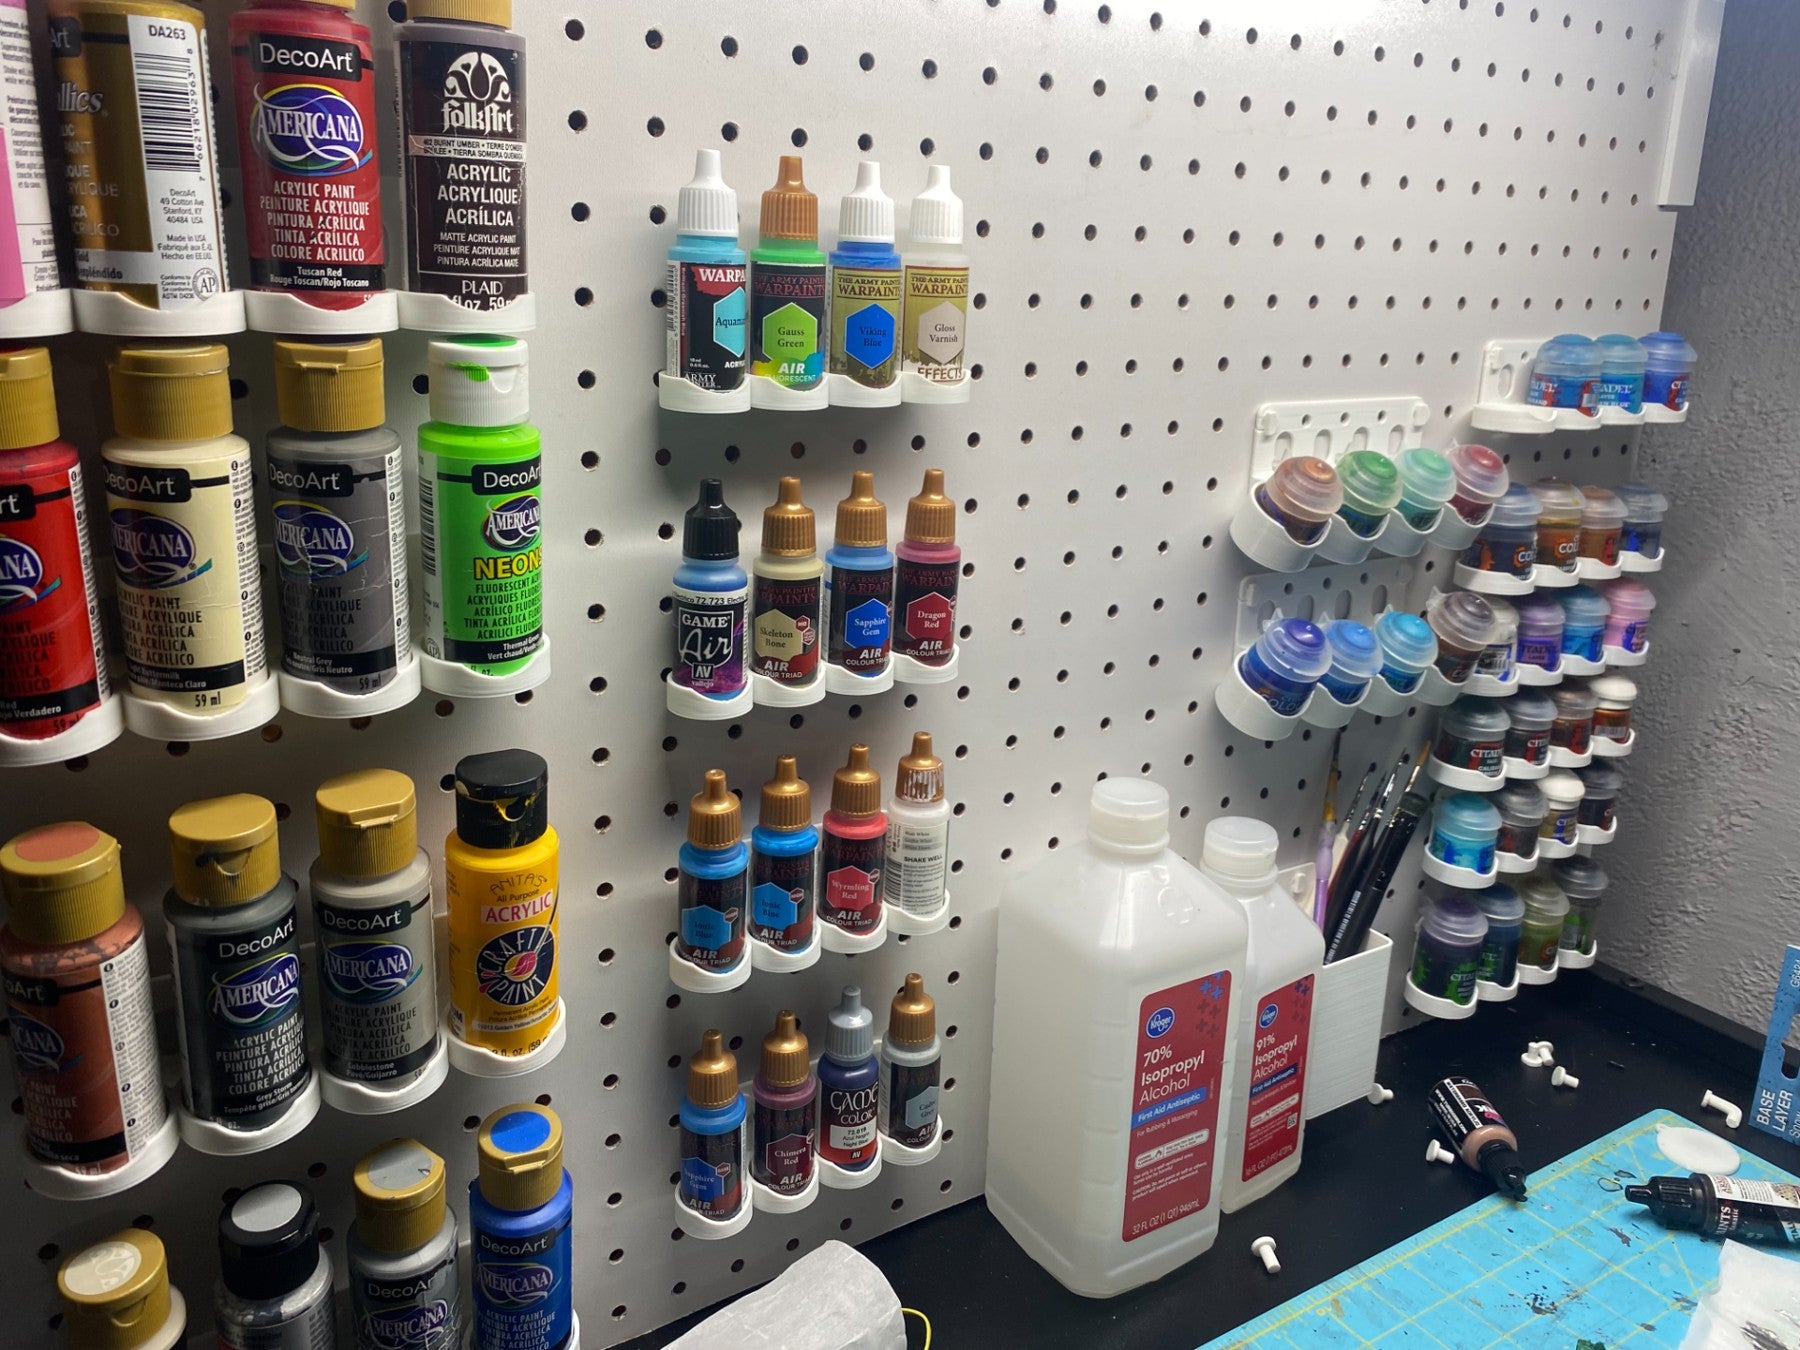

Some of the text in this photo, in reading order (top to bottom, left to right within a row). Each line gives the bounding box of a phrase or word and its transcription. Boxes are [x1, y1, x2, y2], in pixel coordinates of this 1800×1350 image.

[148, 24, 186, 40] DA263
[260, 43, 353, 73] DecoArt
[255, 102, 361, 143] AMERICANA
[434, 138, 505, 151] BURNT UMBER TERRE
[452, 148, 503, 159] TIERRA SOMBRA
[446, 163, 511, 183] ACRYLIC
[273, 180, 356, 199] ACRYLIC PAINT
[437, 185, 518, 205] ACRYLIQUE
[260, 196, 370, 216] PEINTURE ACRYLIQUE
[266, 212, 366, 231] PINTURA ACRÍLICA
[445, 205, 514, 226] ACRÍLICA
[166, 234, 187, 242] Made
[274, 228, 360, 246] TINTA ACRÍLICA
[440, 231, 517, 244] MATTE ACRYLIC PAINT
[161, 252, 184, 260] Hecho
[271, 244, 365, 262] COLORE ACRILICO
[433, 244, 509, 256] PEINTURE ACRYLIQUE
[437, 256, 503, 268] PINTURA ACRÍLICA
[297, 266, 343, 277] Tuscan Red
[199, 276, 217, 293] AP
[269, 273, 370, 289] Rouge Toscan/Rojo Toscano
[462, 280, 503, 295] PLAID
[854, 278, 878, 286] ARMY
[777, 326, 805, 337] Gauss
[859, 327, 887, 338] Viking
[934, 323, 956, 333] Gloss
[777, 339, 805, 348] Green
[863, 338, 882, 347] Blue
[930, 334, 958, 343] Varnish
[778, 363, 805, 375] AIR
[269, 463, 340, 490] DecoArt
[475, 577, 530, 594] FLUORESCENT
[148, 596, 180, 609] PAINT
[461, 592, 519, 606] ACRYLIQUES
[695, 597, 725, 606] 72.723
[143, 608, 202, 625] ACRYLIQUE
[474, 603, 513, 617] ACRÍLICO
[917, 610, 947, 620] Dragon
[464, 612, 527, 628] TINTA ACRÍLICA
[681, 614, 729, 628] GAME
[854, 618, 886, 628] Sapphire
[146, 622, 195, 638] ACRÍLICA
[477, 626, 513, 640] ACRILICI
[760, 626, 793, 638] Skeleton
[503, 637, 528, 650] Thermal
[680, 628, 732, 662] Air
[765, 638, 786, 648] Bone
[919, 640, 943, 651] AIR
[147, 650, 195, 666] ACRILICO
[487, 650, 503, 660] Vert
[860, 648, 882, 659] AIR
[906, 648, 936, 657] COLOUR
[315, 657, 333, 666] Grey
[763, 660, 790, 671] AIR
[845, 659, 875, 667] COLOUR
[695, 666, 712, 678] AV
[184, 680, 207, 689] Claro
[195, 691, 221, 708] 59 ml
[14, 706, 61, 718] Verdadero
[1470, 748, 1501, 760] CITAD
[927, 855, 943, 863] WELL
[832, 879, 870, 892] Wyrmling
[497, 889, 539, 903] All Purpose
[842, 891, 857, 900] Red
[485, 891, 551, 923] ACRYLIC
[762, 910, 780, 918] Blue
[324, 909, 402, 930] DecoArt
[826, 915, 873, 927] COLOUR TRIAD
[837, 910, 862, 921] AIR
[219, 918, 295, 958] DecoArt
[760, 928, 784, 940] AIR
[692, 948, 718, 959] AIR
[323, 953, 408, 979] AMERICANA
[212, 961, 298, 1014] AMERICANA
[488, 974, 545, 1004] PAINT
[374, 1002, 402, 1016] PAINT
[366, 1006, 417, 1028] ACRYLIQUE
[1150, 1014, 1173, 1032] Kroger
[233, 1012, 298, 1048] ACRYLIC PAINT
[1256, 1032, 1275, 1051] 91%
[215, 1043, 267, 1061] PEINTURE
[1144, 1043, 1173, 1067] 70%
[1255, 1034, 1298, 1067] Isopropyl
[225, 1054, 270, 1072] PINTURA
[1141, 1050, 1205, 1087] Isopropyl
[1253, 1052, 1288, 1081] Alcohol
[229, 1053, 305, 1094] COLORE ACRILICO
[234, 1069, 263, 1083] TINTA
[256, 1081, 293, 1102] Grey Storm
[1139, 1072, 1191, 1106] Alcohol
[830, 1081, 879, 1115] GAME
[1138, 1092, 1201, 1122] First Aid Antiseptic
[1756, 1088, 1775, 1125] BASE
[1772, 1089, 1793, 1132] LAYER
[841, 1107, 873, 1125] COLOR
[1145, 1121, 1166, 1135] Rubbing
[774, 1146, 807, 1158] Chimera
[780, 1172, 803, 1185] AIR
[768, 1181, 796, 1192] COLOUR
[690, 1198, 711, 1210] AIR
[481, 1236, 548, 1255] DecoArt
[512, 1311, 555, 1333] ACRYLIQUE
[520, 1309, 544, 1323] PAINT
